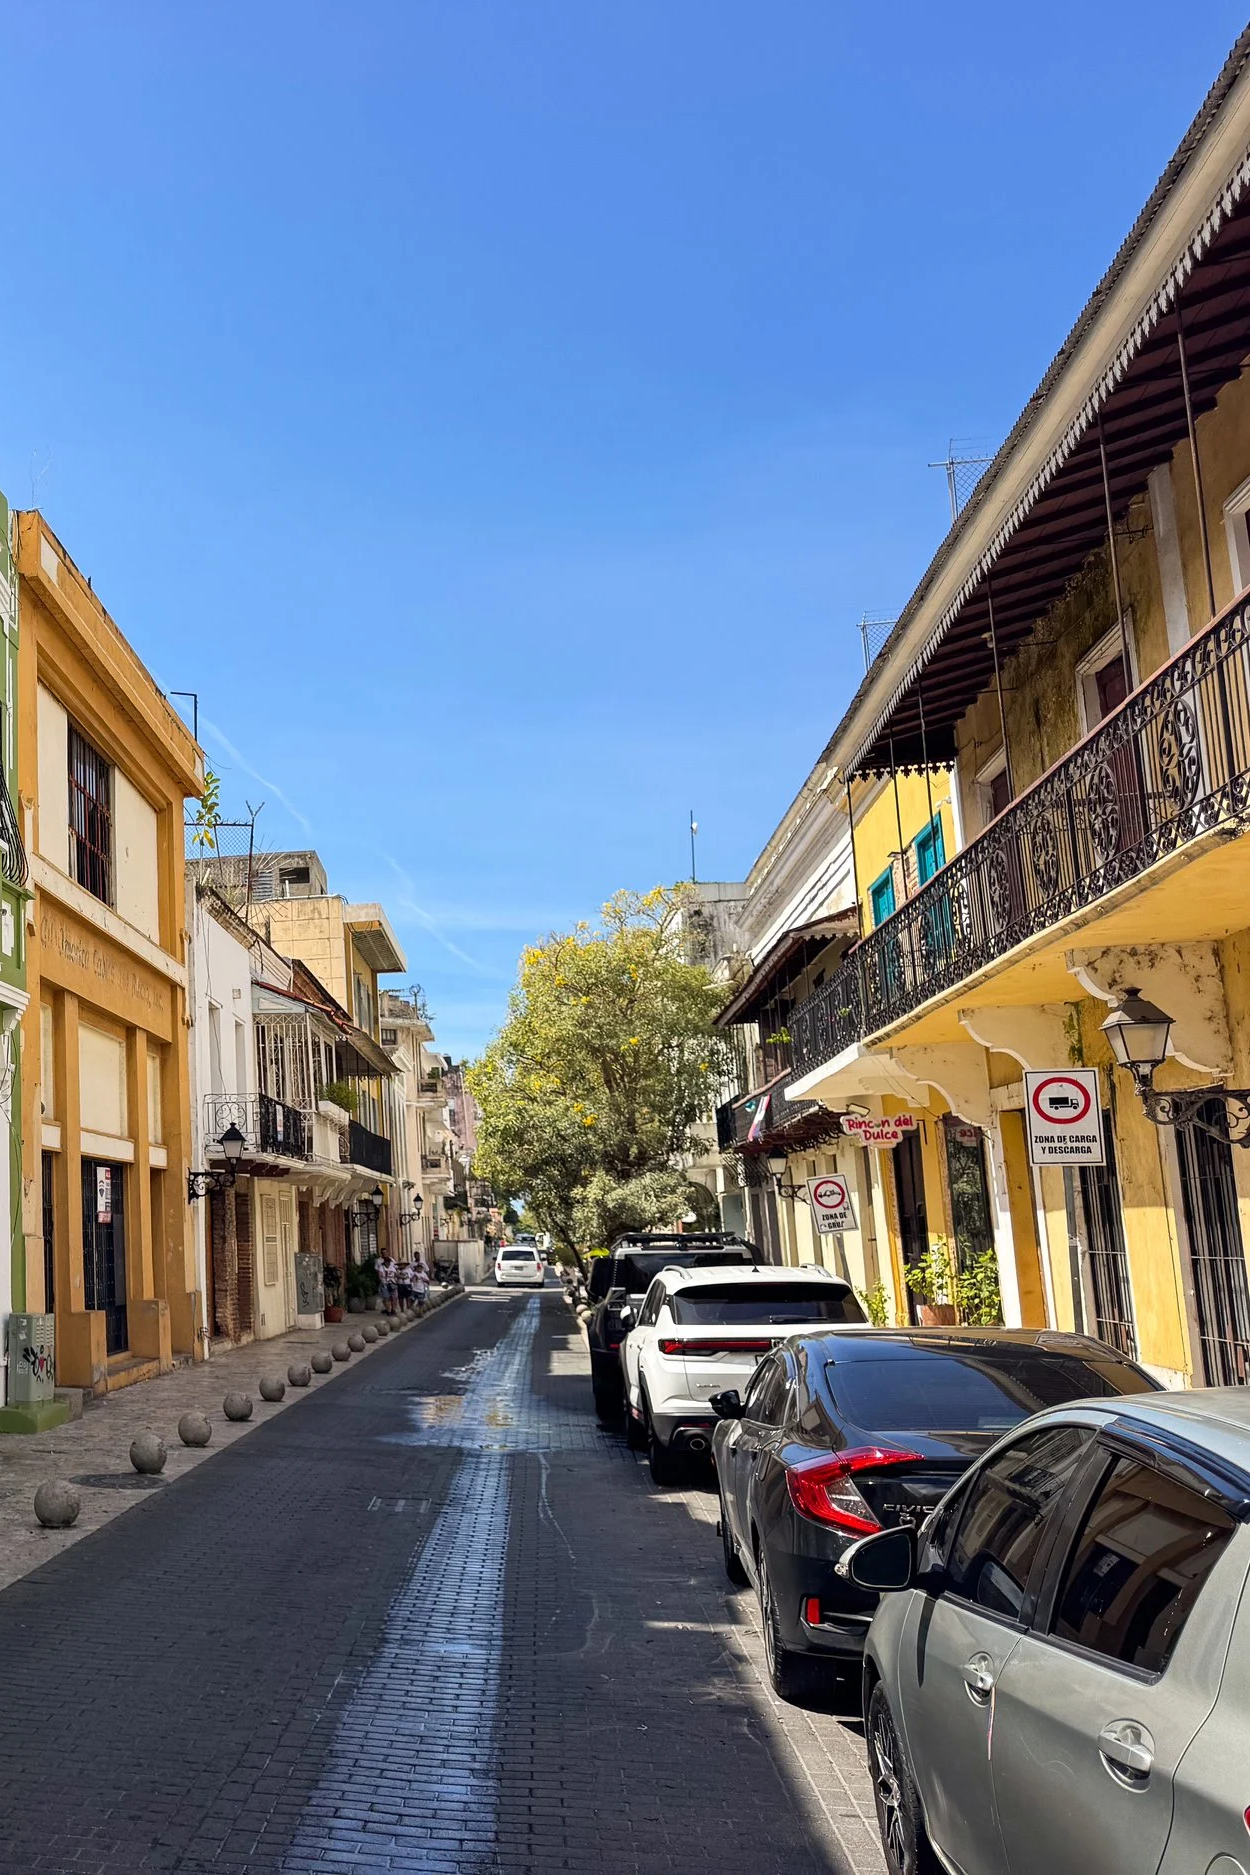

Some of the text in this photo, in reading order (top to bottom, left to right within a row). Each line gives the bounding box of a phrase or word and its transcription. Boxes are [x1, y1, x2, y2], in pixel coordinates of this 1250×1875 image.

[894, 1114, 913, 1128] del
[863, 1129, 899, 1141] Dulce
[1034, 1135, 1098, 1144] ZONA DE CARGA
[1041, 1146, 1093, 1154] Y DESCARGA
[822, 1211, 847, 1221] ZONA DE
[883, 1503, 936, 1514] CIVIC
